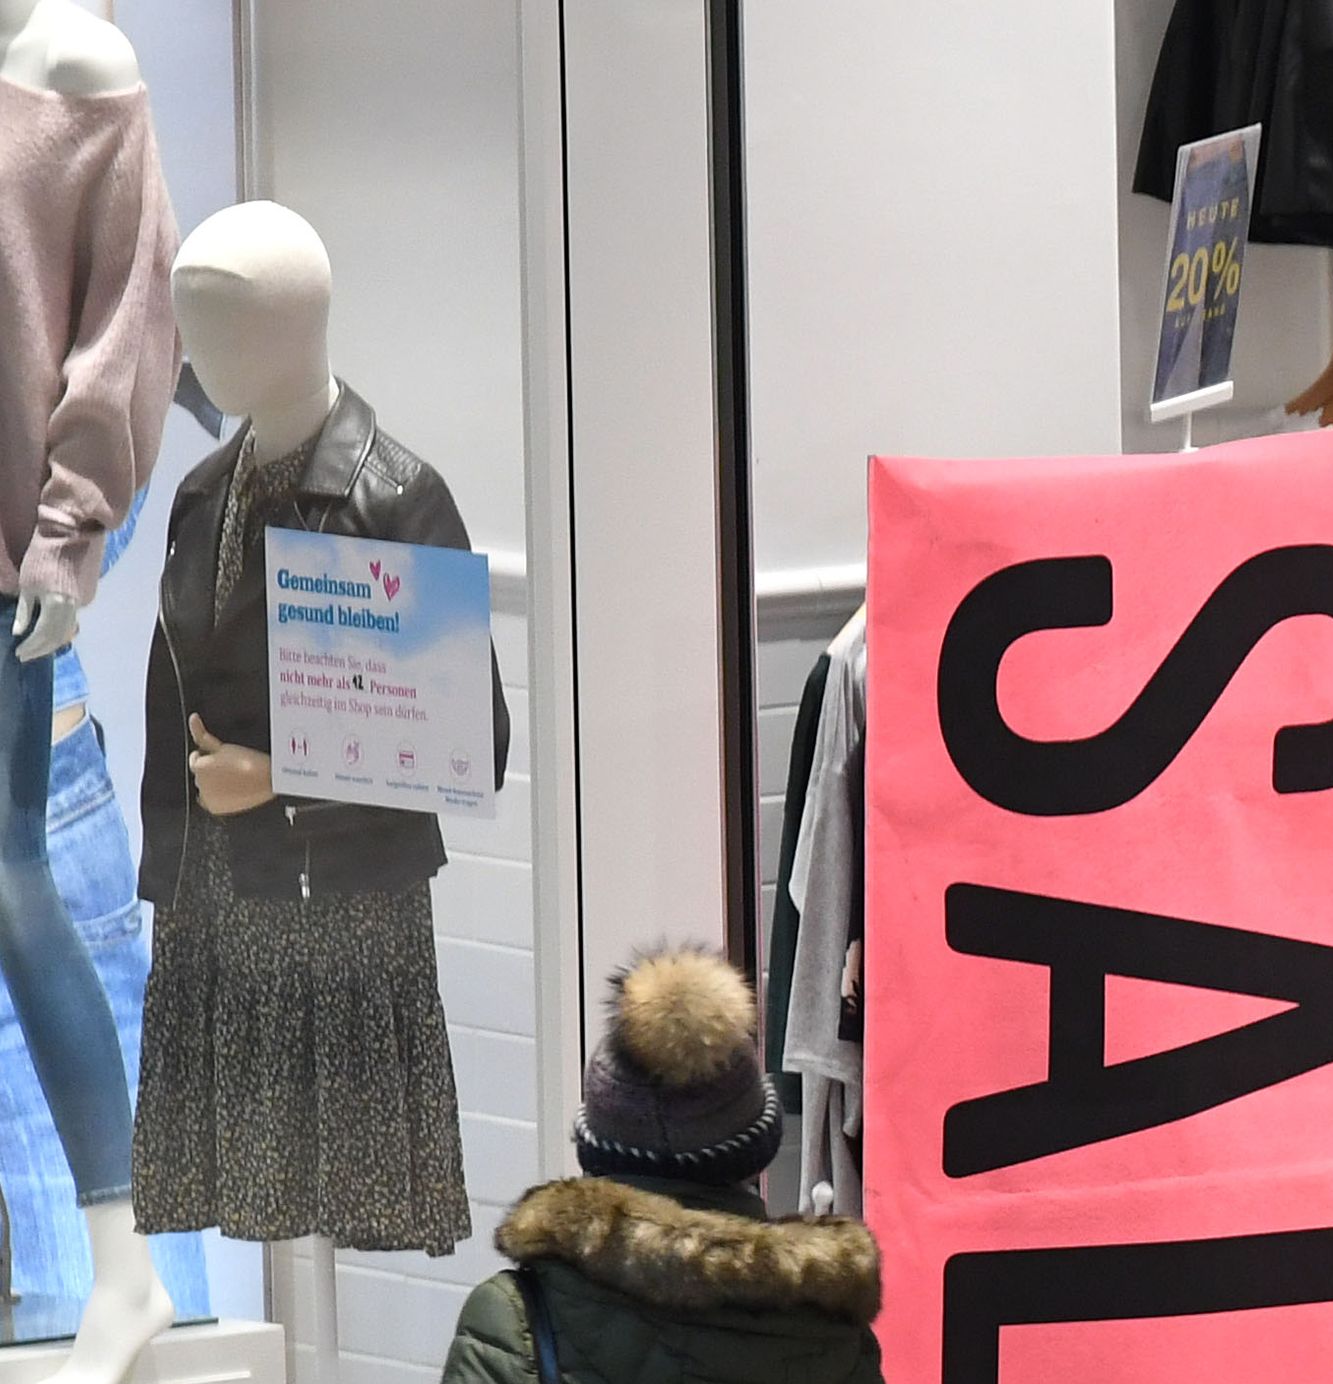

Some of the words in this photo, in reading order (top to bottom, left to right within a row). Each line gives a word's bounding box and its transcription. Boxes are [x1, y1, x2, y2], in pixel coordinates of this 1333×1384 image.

[1186, 197, 1240, 230] HEUTE
[1165, 236, 1241, 312] 20%
[277, 568, 372, 600] Gemeinsam
[277, 601, 334, 624] gesund
[338, 605, 400, 634] bleiben!
[279, 647, 302, 663] Bitte
[303, 648, 346, 669] beachten
[279, 670, 305, 686] nicht
[306, 674, 333, 689] mehr
[336, 676, 351, 691] als
[369, 680, 417, 700] Personen
[348, 699, 372, 720] Shop
